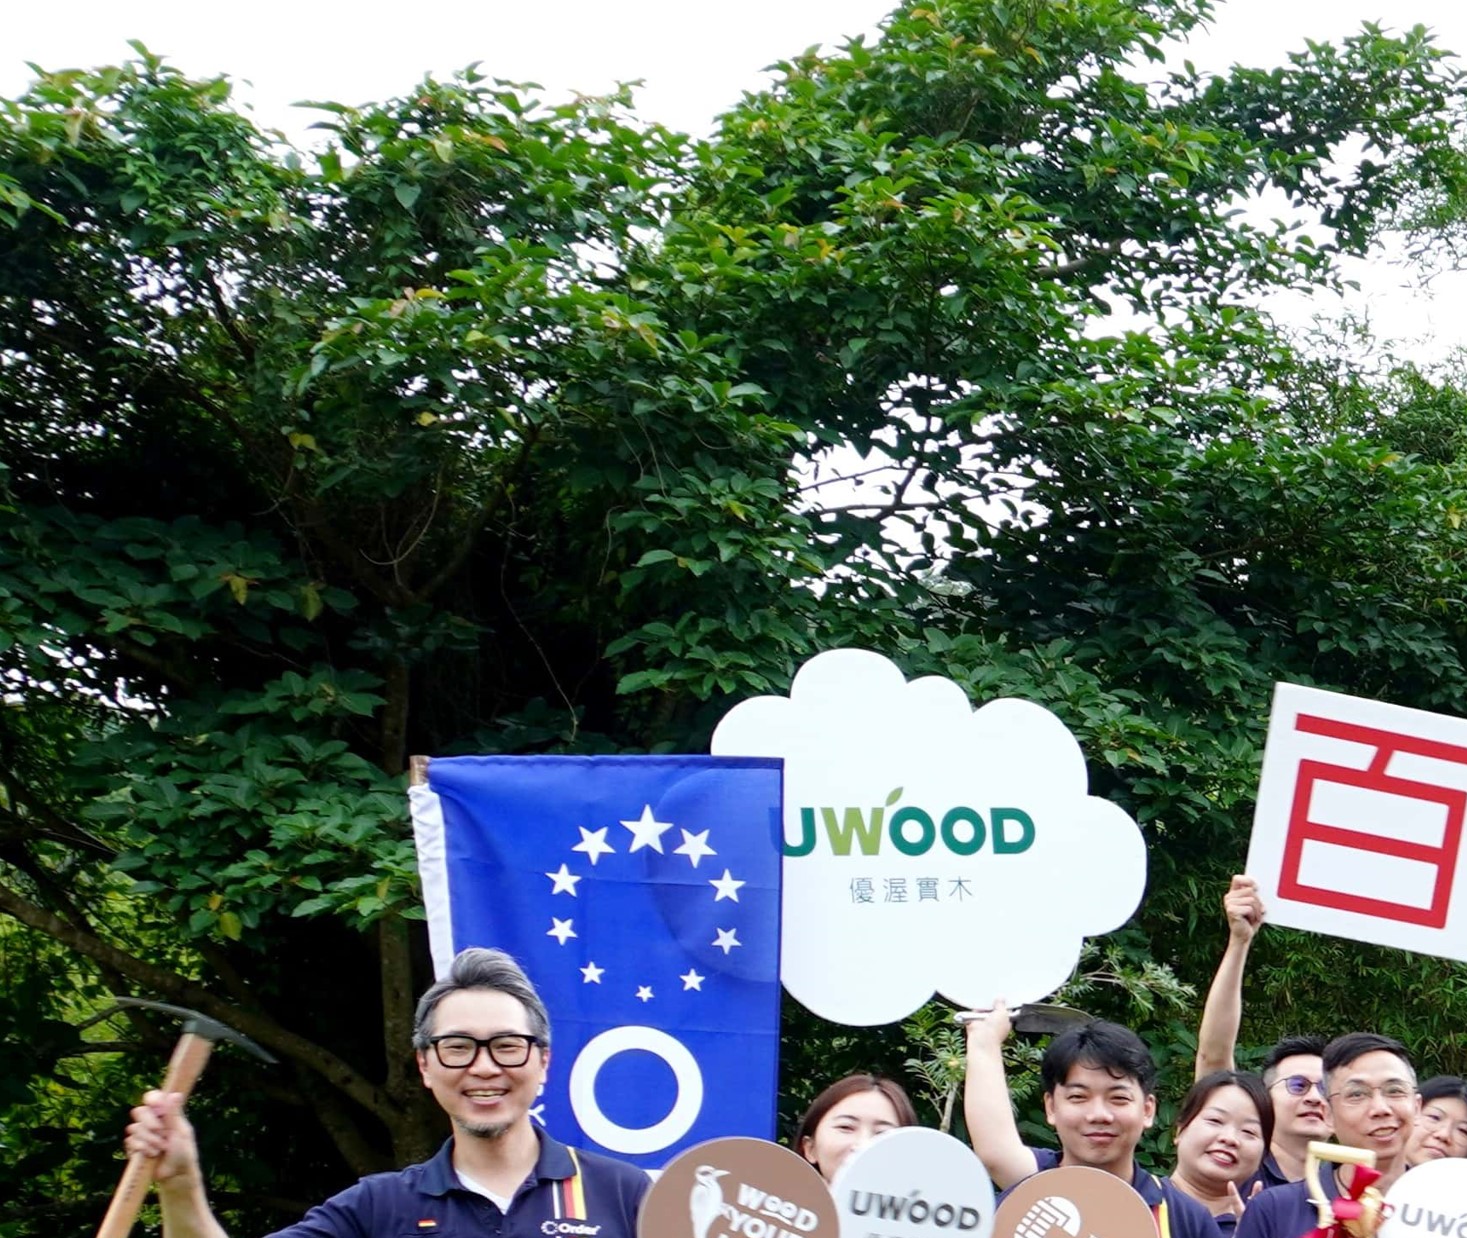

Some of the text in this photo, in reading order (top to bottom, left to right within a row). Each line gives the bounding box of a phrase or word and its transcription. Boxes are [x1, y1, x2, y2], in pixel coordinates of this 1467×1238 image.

[849, 876, 973, 904] 優渥實木
[737, 1183, 818, 1232] WOOD
[850, 1189, 979, 1230] UWOOD
